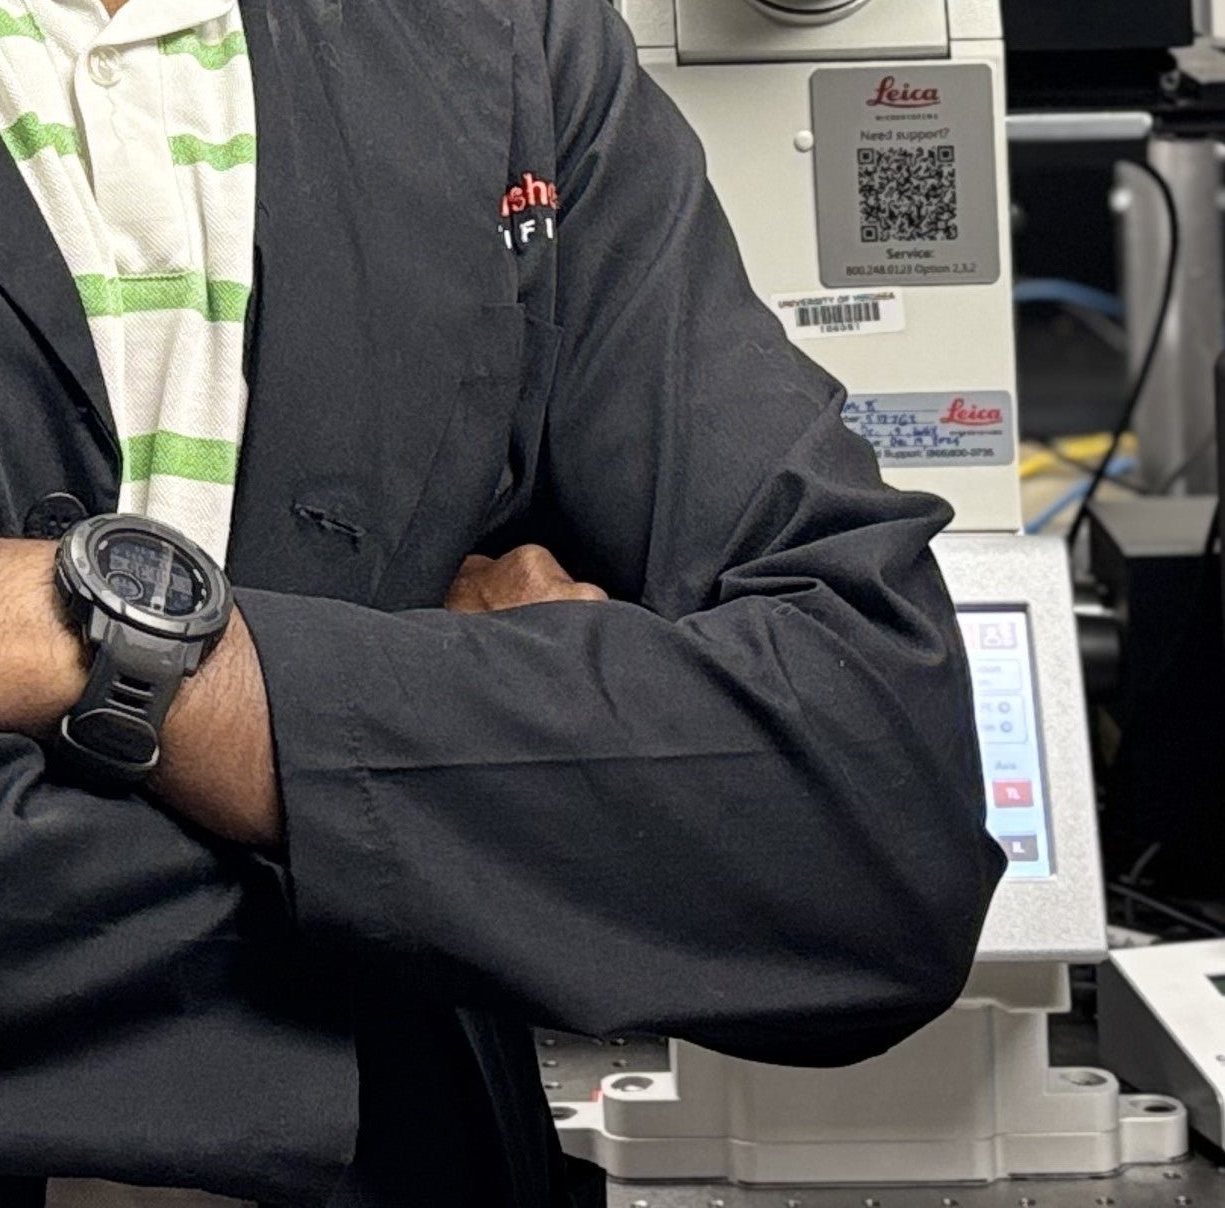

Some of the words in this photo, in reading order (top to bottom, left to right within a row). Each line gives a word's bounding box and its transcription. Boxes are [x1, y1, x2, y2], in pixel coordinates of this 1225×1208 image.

[866, 76, 940, 108] Leica
[860, 130, 892, 141] Need
[896, 127, 949, 142] support?
[940, 398, 1003, 426] Leica
